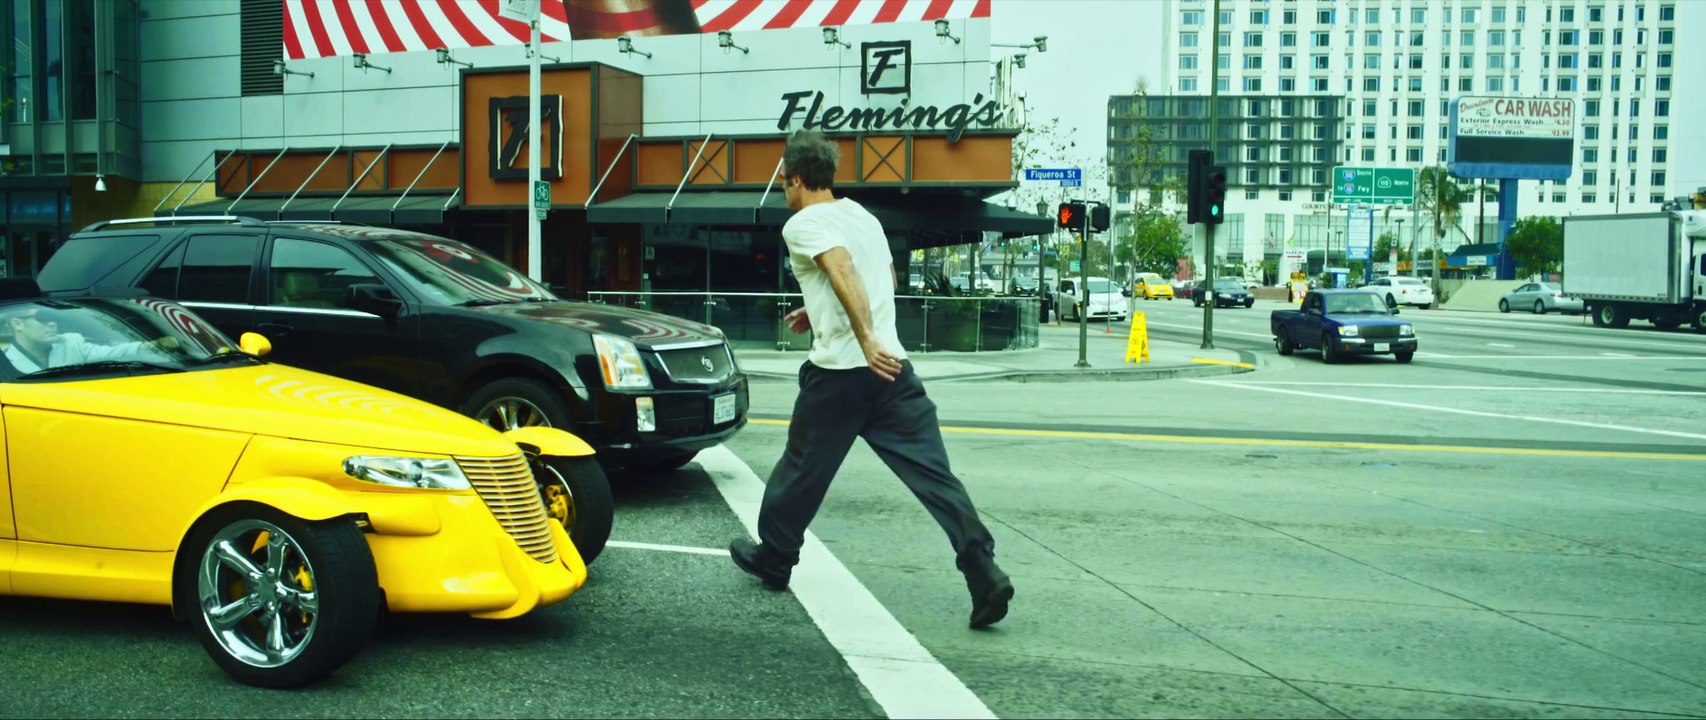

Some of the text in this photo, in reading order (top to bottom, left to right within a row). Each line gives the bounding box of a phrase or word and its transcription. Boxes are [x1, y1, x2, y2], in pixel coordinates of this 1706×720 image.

[868, 48, 905, 87] F
[777, 90, 1003, 144] Fleming's
[1495, 99, 1571, 117] CAR WASH
[1031, 170, 1076, 180] Figueroa St
